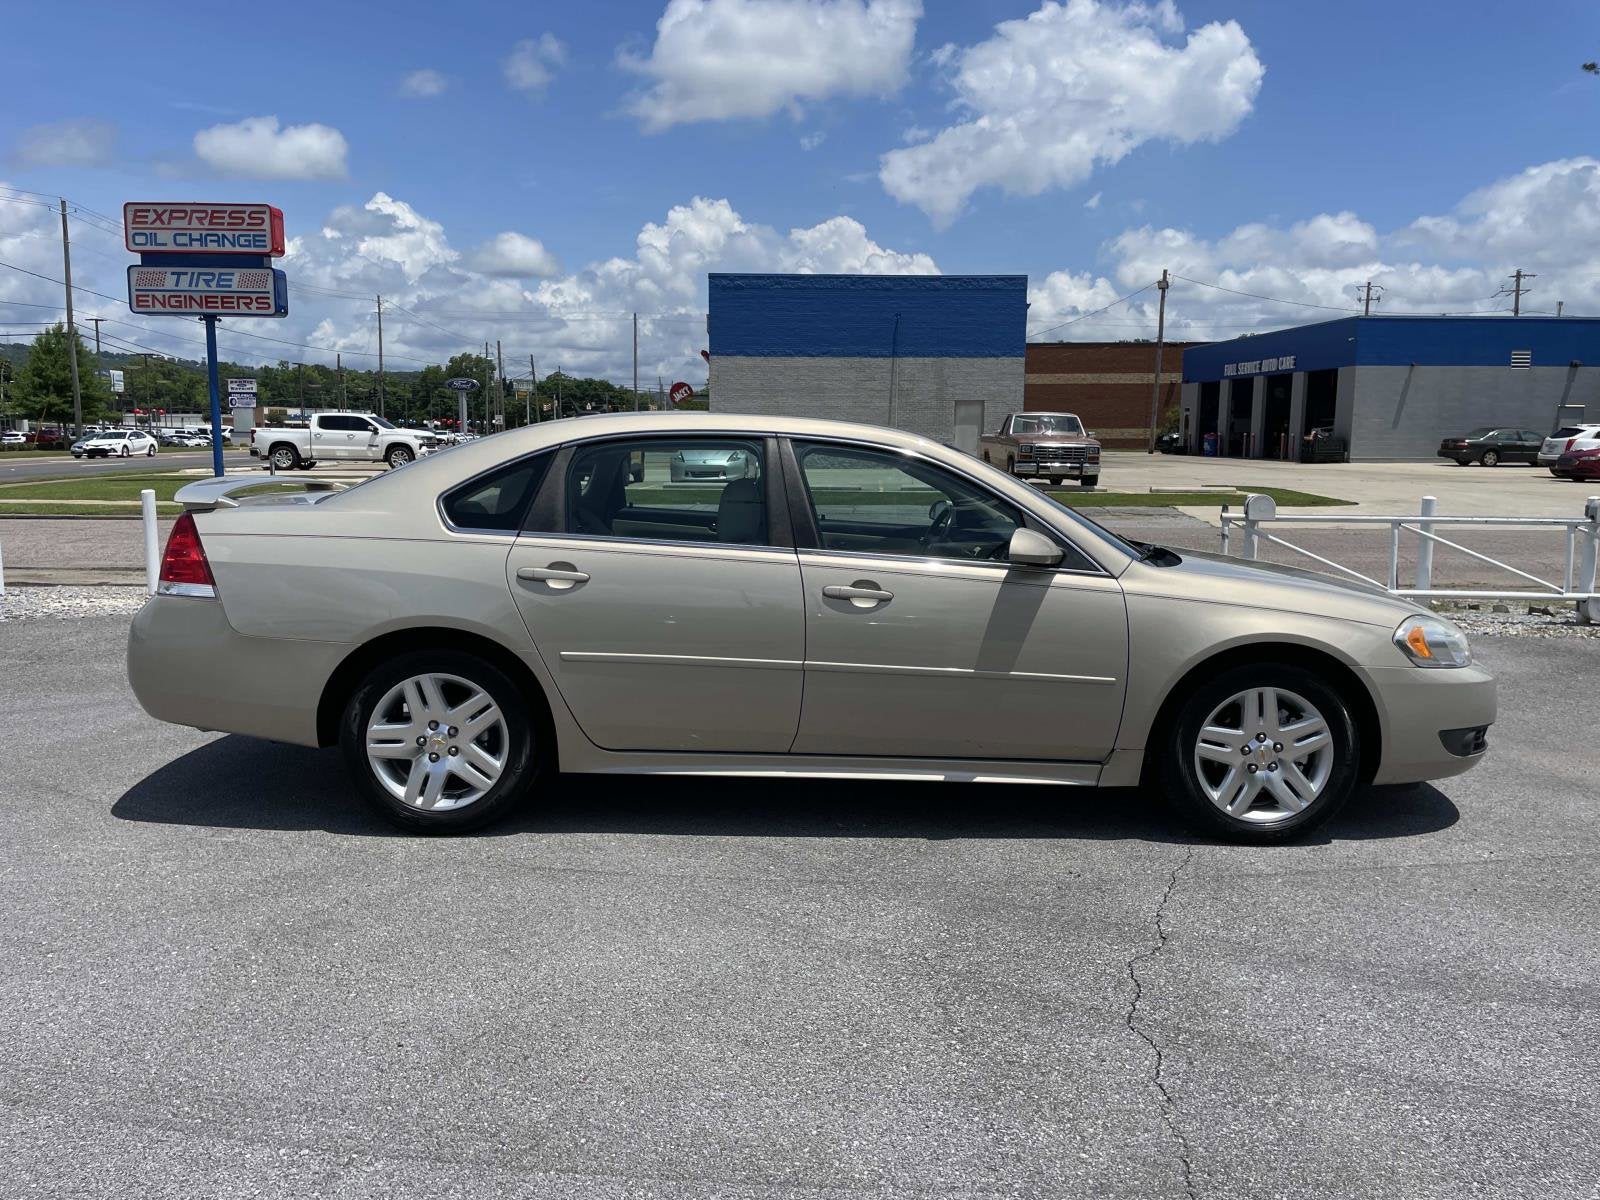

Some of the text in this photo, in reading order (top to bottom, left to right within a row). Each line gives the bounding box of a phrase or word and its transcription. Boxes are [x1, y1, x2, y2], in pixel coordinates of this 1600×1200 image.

[131, 208, 267, 227] EXPRESS
[131, 232, 268, 249] OIL CHANGE
[170, 271, 235, 289] TIRE
[135, 294, 272, 311] ENGINEERS
[1238, 361, 1261, 375] SERVICE
[1261, 358, 1278, 372] AUTO
[1278, 356, 1296, 370] CARE
